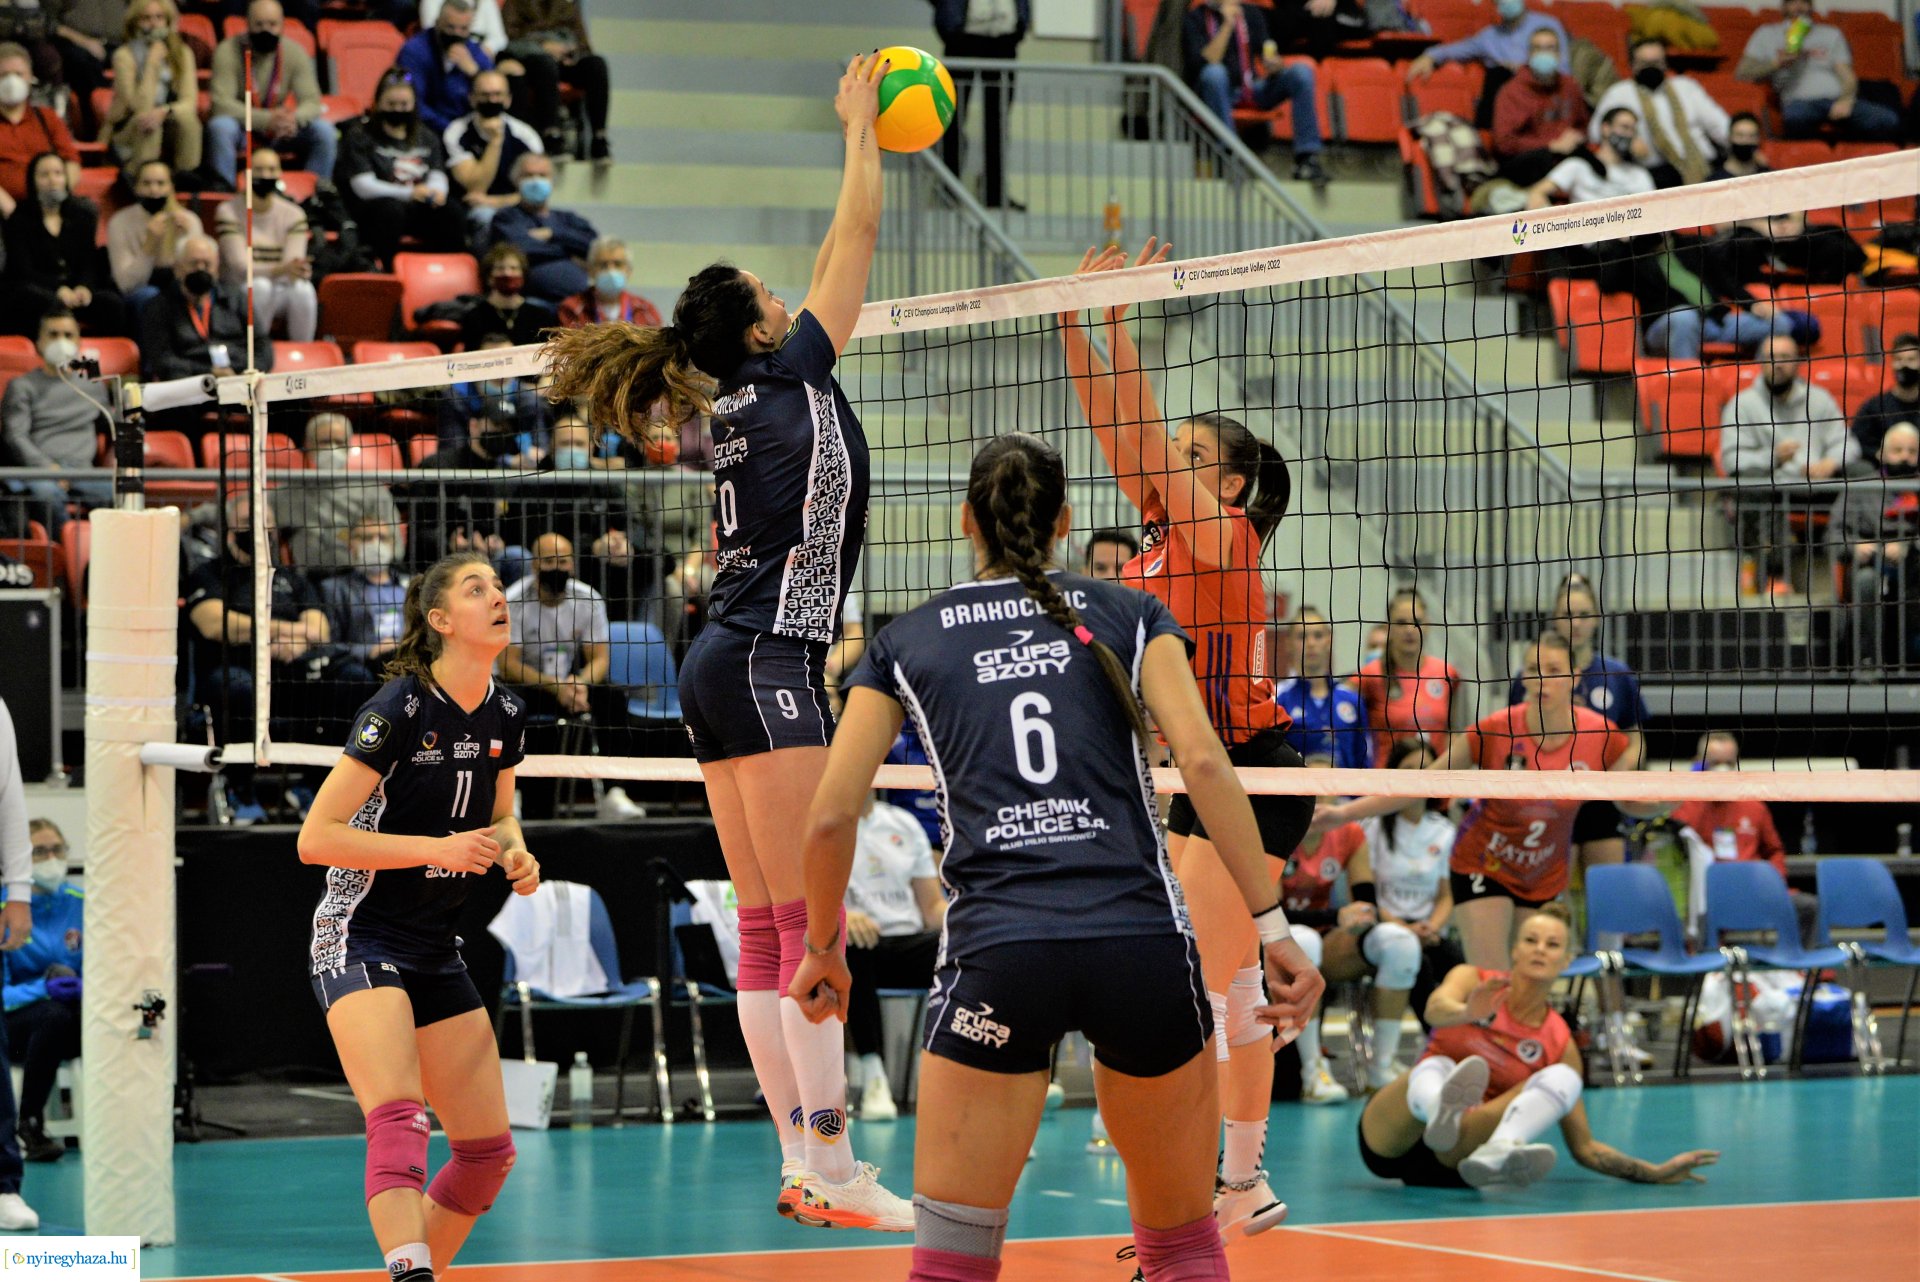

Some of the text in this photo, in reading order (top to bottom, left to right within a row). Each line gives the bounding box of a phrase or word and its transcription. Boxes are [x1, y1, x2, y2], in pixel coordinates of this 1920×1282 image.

[1532, 208, 1642, 234] CEV Champions League Volley 2022
[1189, 259, 1280, 280] CEV Champions League Volley 2022
[904, 300, 981, 318] CEV Champions League Volley 2022
[776, 689, 799, 720] 9
[370, 716, 384, 727] CEV
[1010, 691, 1058, 785] 6
[416, 749, 442, 757] CHEMIK
[451, 770, 473, 819] 11
[997, 798, 1092, 823] CHEMIK
[985, 813, 1110, 844] POLICE S.A.
[1523, 820, 1547, 848] 2
[1469, 872, 1486, 894] 2
